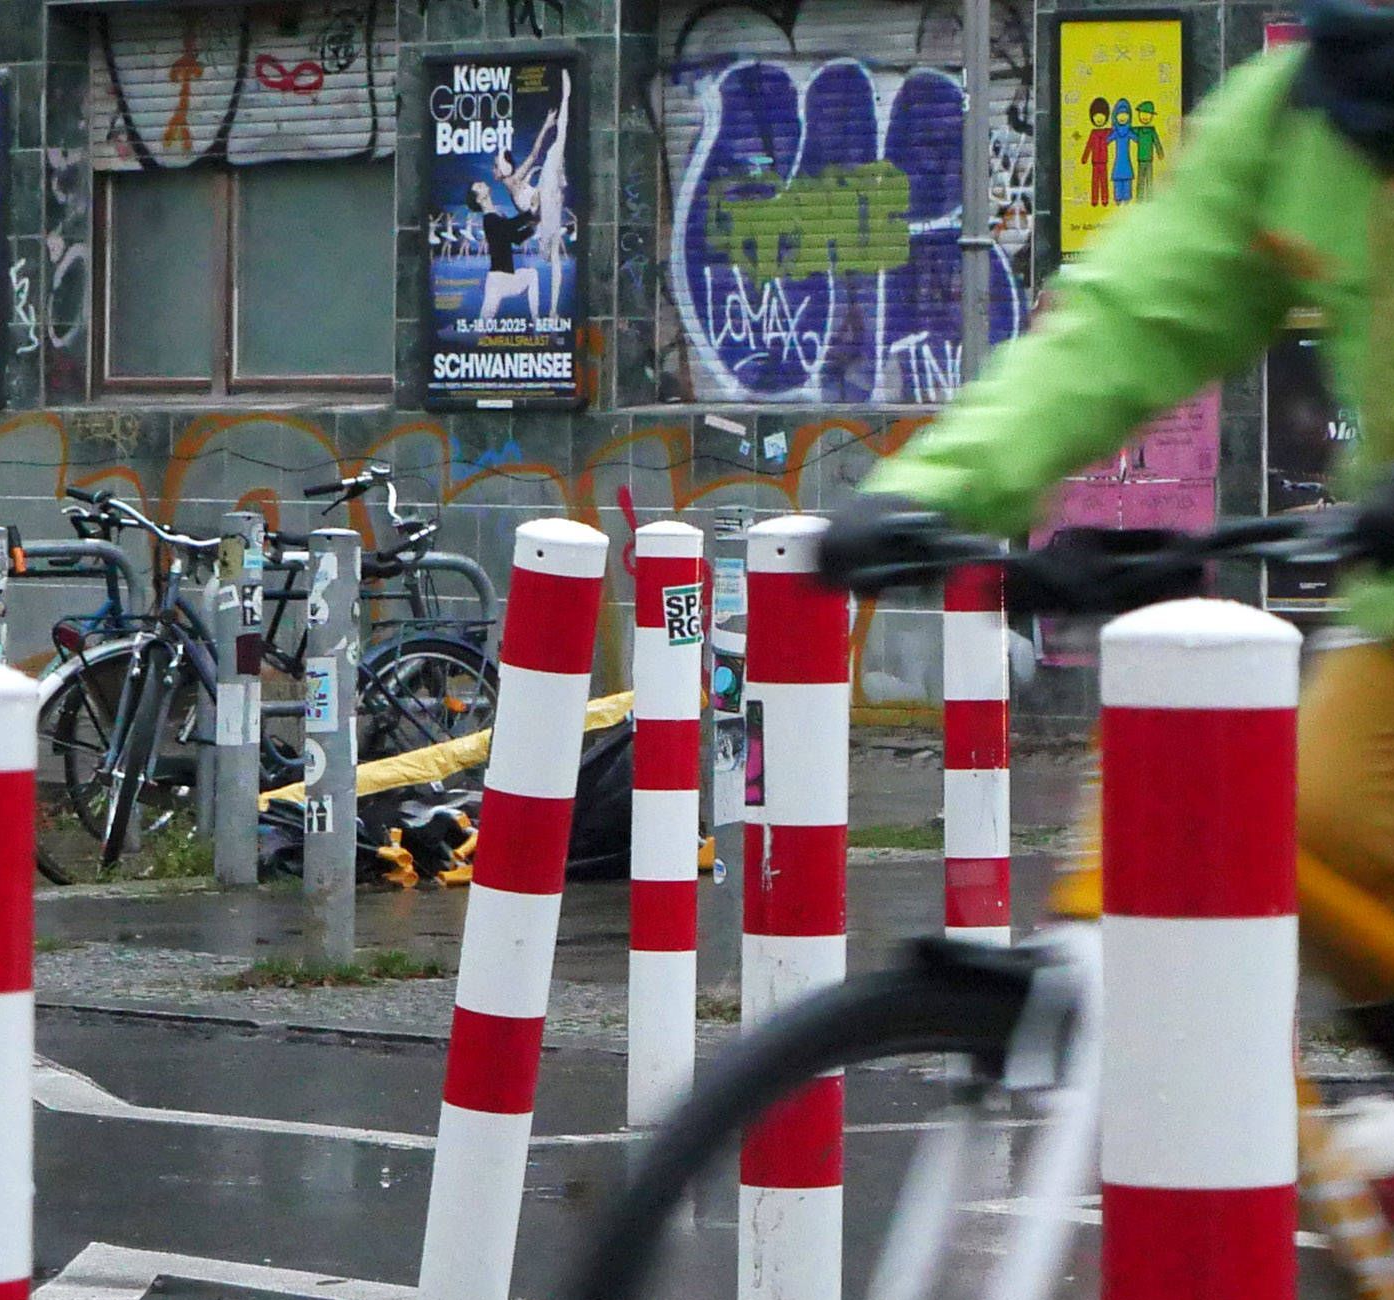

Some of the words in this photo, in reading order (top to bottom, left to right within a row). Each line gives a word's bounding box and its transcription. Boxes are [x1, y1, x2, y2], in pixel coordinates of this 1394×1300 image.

[453, 64, 512, 93] Kiew
[430, 83, 513, 121] Grand
[436, 119, 514, 155] Ballett
[535, 317, 572, 332] BERLIN
[433, 352, 573, 379] SCHWANENSEE
